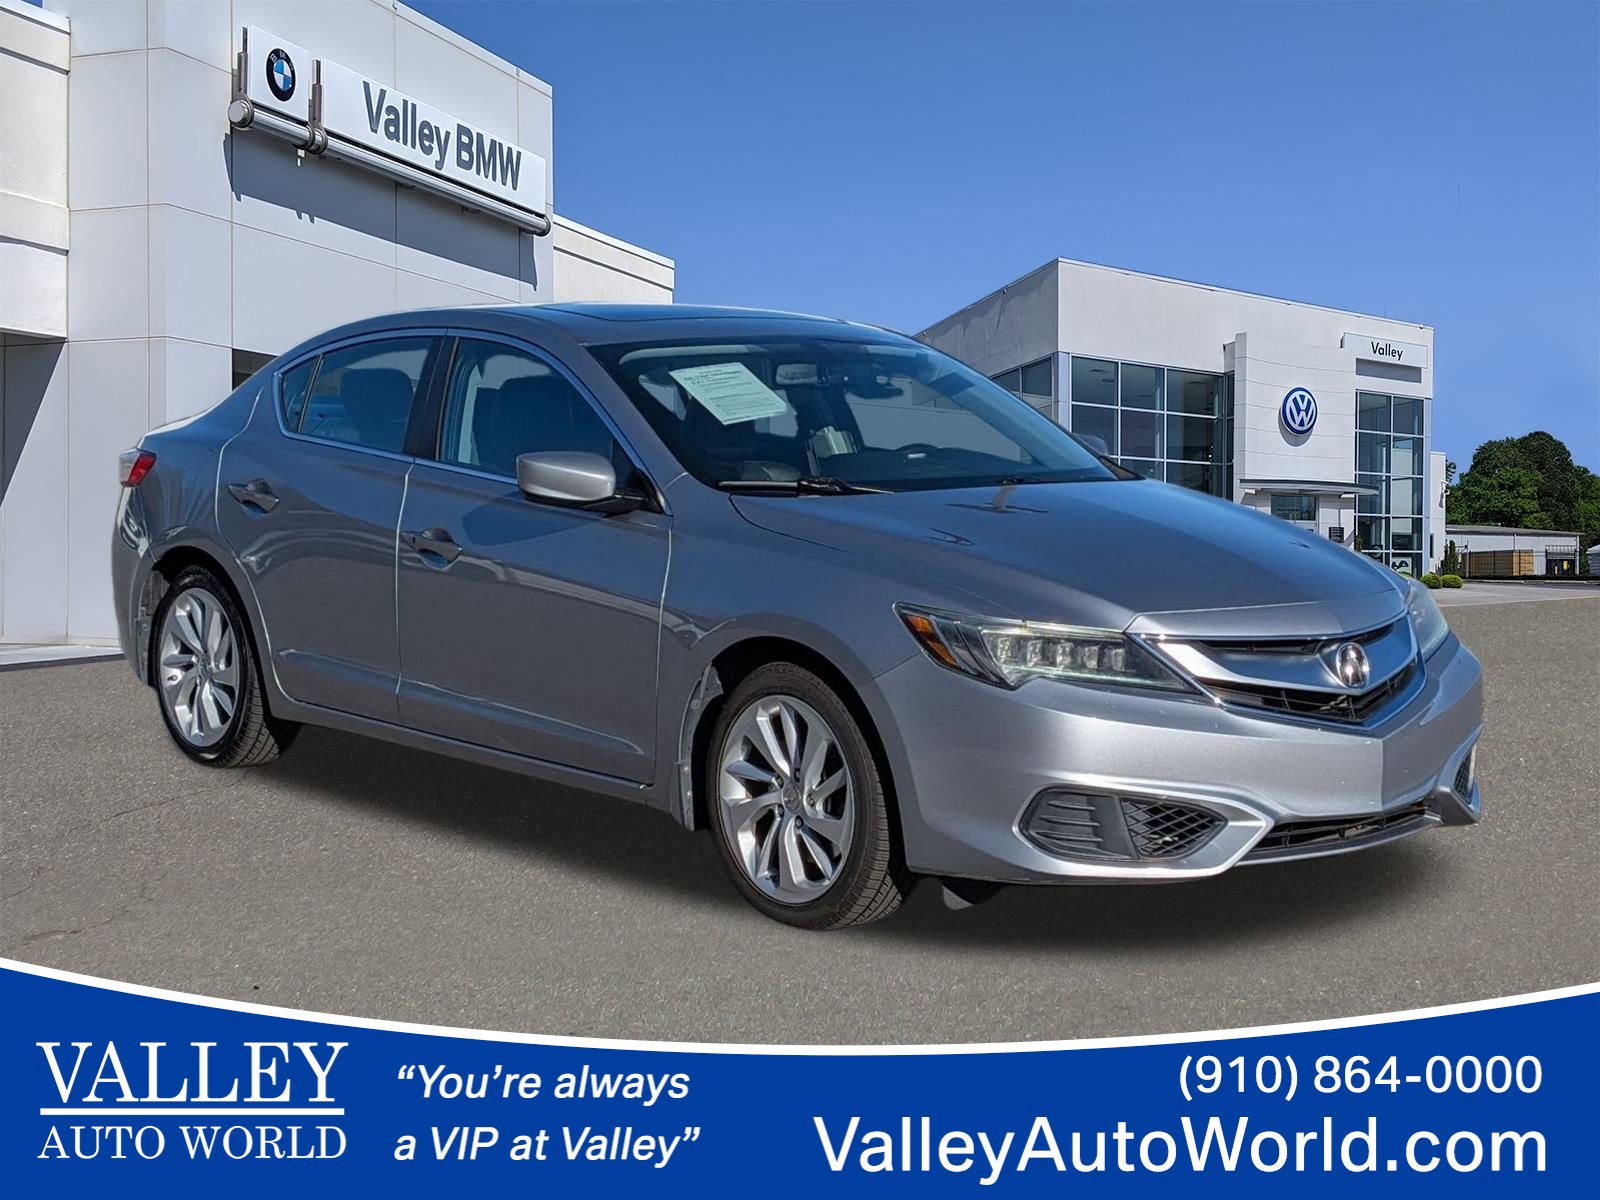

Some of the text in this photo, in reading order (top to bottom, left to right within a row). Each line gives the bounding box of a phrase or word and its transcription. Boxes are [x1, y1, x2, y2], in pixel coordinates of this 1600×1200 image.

[362, 80, 522, 191] Valley BMW
[1371, 341, 1404, 361] Valley
